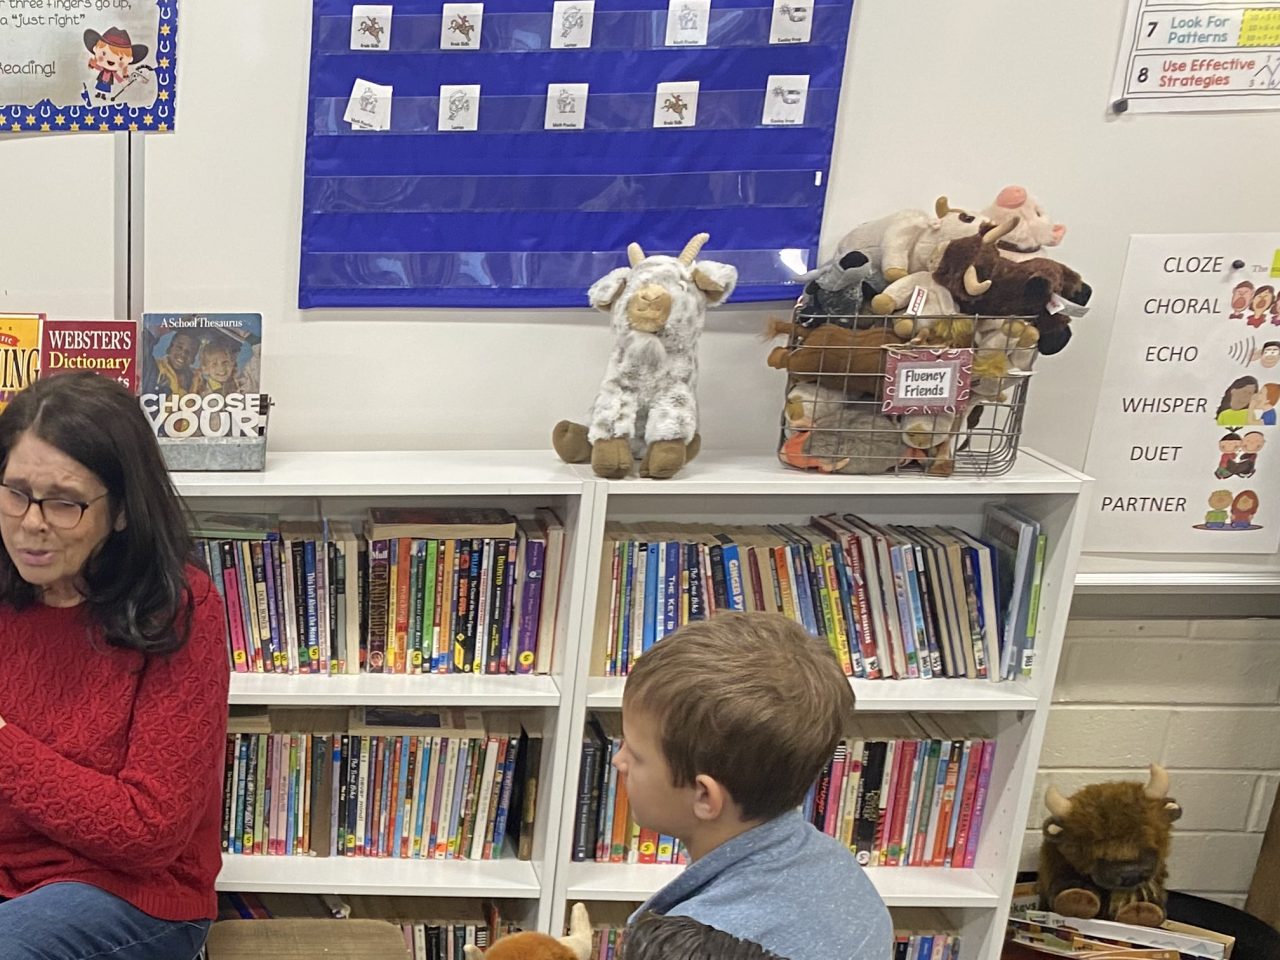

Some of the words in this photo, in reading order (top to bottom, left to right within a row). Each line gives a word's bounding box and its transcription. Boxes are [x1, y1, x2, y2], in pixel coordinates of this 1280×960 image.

[0, 17, 8, 25] a
[12, 14, 45, 27] "just
[48, 14, 86, 28] right"
[1171, 16, 1202, 29] Look
[1206, 16, 1230, 28] For
[1147, 22, 1158, 38] 7
[1168, 32, 1228, 44] Patterns
[1162, 60, 1187, 72] Use
[1190, 58, 1255, 71] Effective
[1138, 67, 1149, 83] 8
[1159, 75, 1230, 88] Strategies
[1164, 256, 1224, 272] CLOZE
[1144, 298, 1222, 314] CHORAL
[160, 318, 168, 327] A
[169, 317, 197, 328] School
[198, 317, 243, 328] Thesaurus
[49, 330, 132, 349] WEBSTER'S
[1146, 346, 1198, 362] ECHO
[49, 351, 131, 373] Dictionary
[905, 370, 946, 383] Fluency
[905, 385, 944, 396] Friends
[141, 393, 260, 413] CHOOSE
[1123, 398, 1208, 412] WHISPER
[145, 411, 259, 438] YOUR
[1130, 446, 1182, 460] DUET
[1101, 497, 1187, 512] PARTNER
[667, 598, 676, 616] KEY
